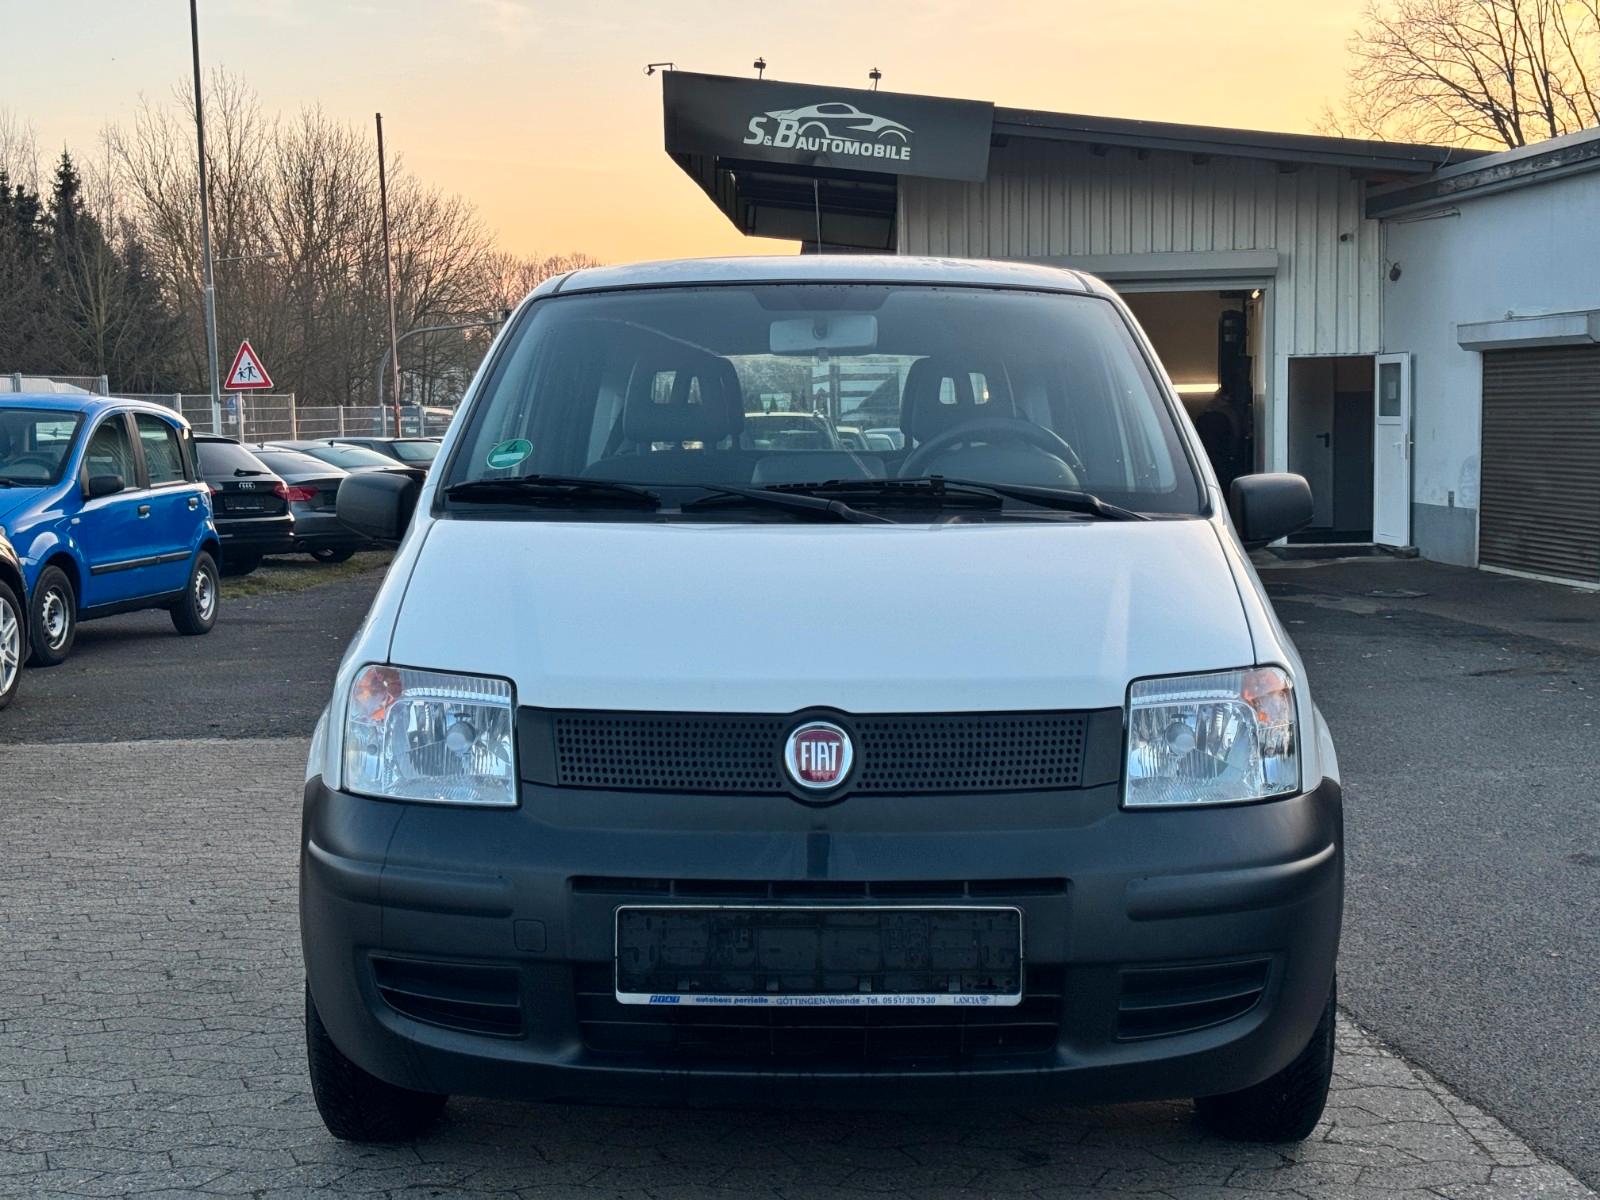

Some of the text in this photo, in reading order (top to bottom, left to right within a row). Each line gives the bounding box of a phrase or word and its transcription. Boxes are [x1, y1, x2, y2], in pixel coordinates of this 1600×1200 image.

[743, 116, 911, 161] S&B AUTOMOBILE
[504, 439, 518, 453] 4
[800, 741, 840, 771] FIAT
